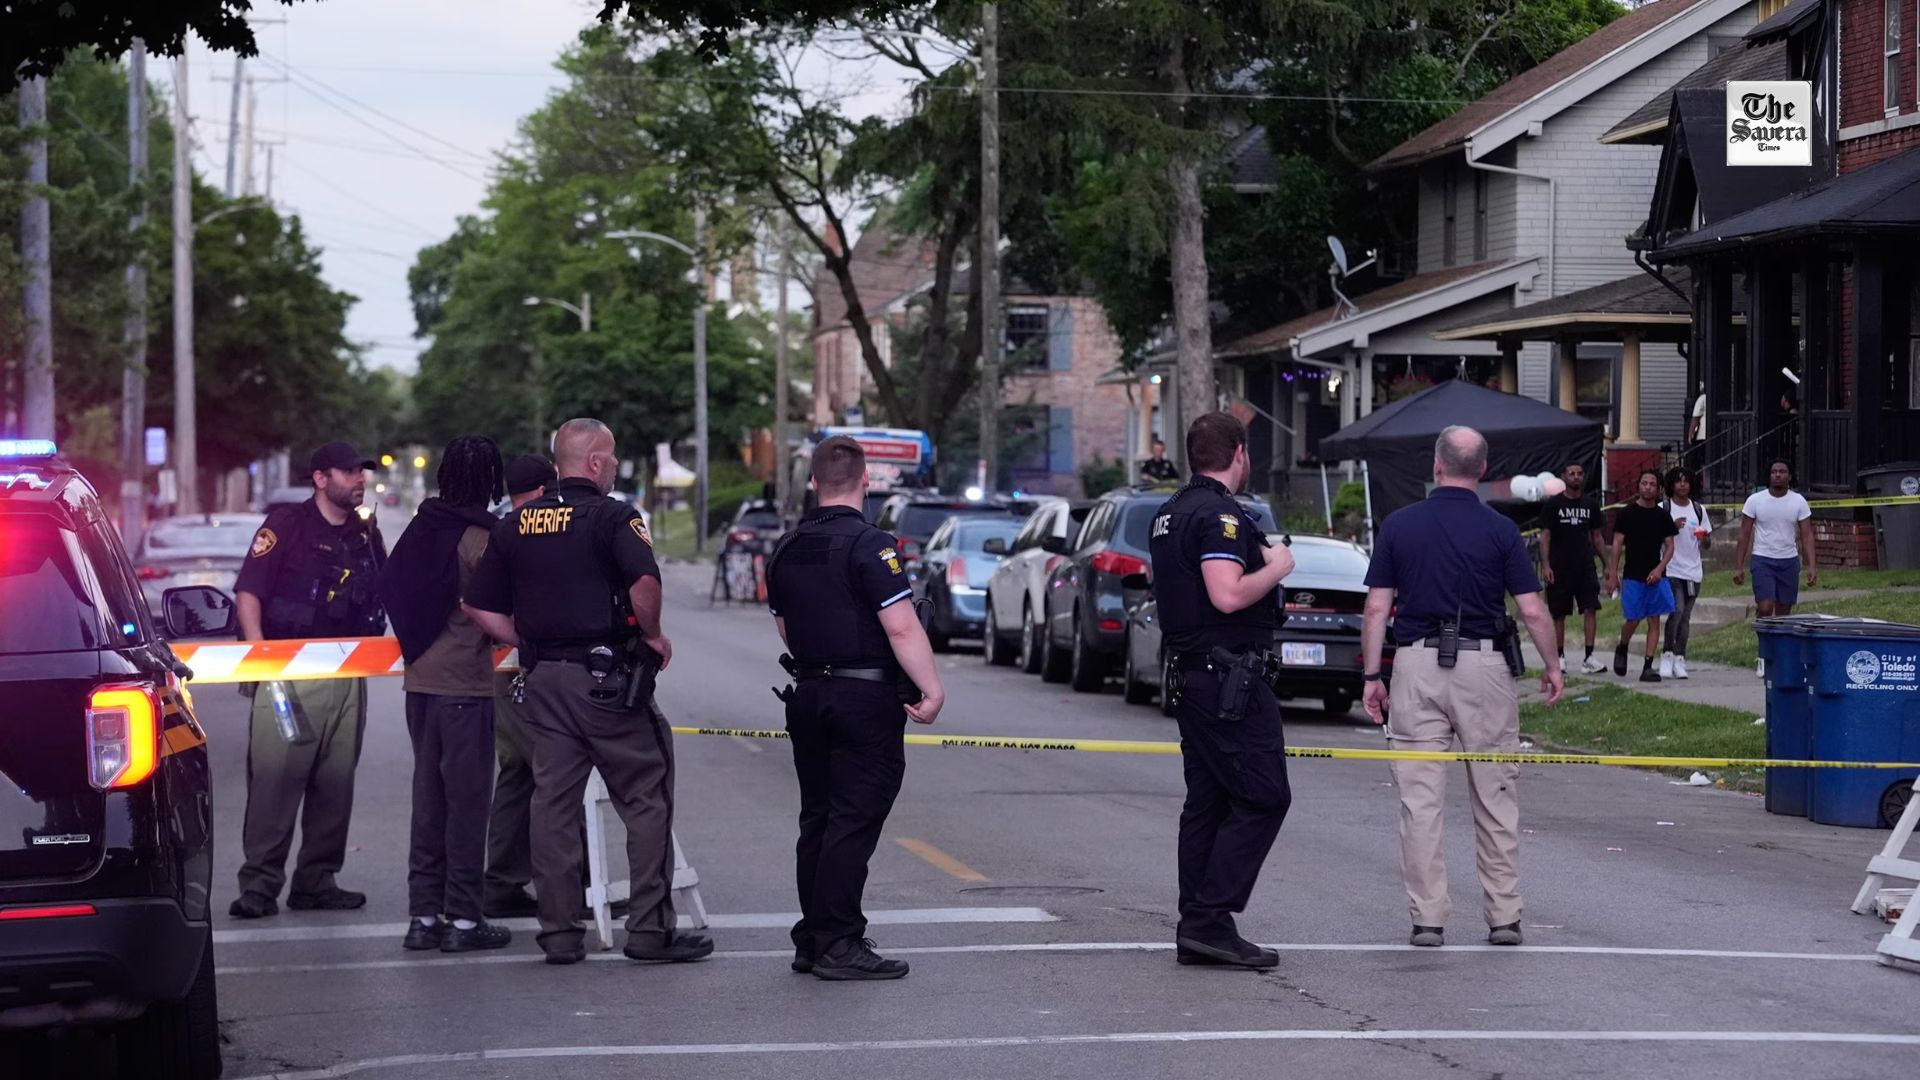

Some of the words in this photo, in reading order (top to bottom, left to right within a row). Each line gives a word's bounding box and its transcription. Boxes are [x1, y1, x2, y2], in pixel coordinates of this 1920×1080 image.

[1558, 507, 1590, 518] AMIRI
[519, 507, 573, 535] SHERIFF
[1881, 654, 1901, 663] City
[1881, 662, 1916, 672] Toledo
